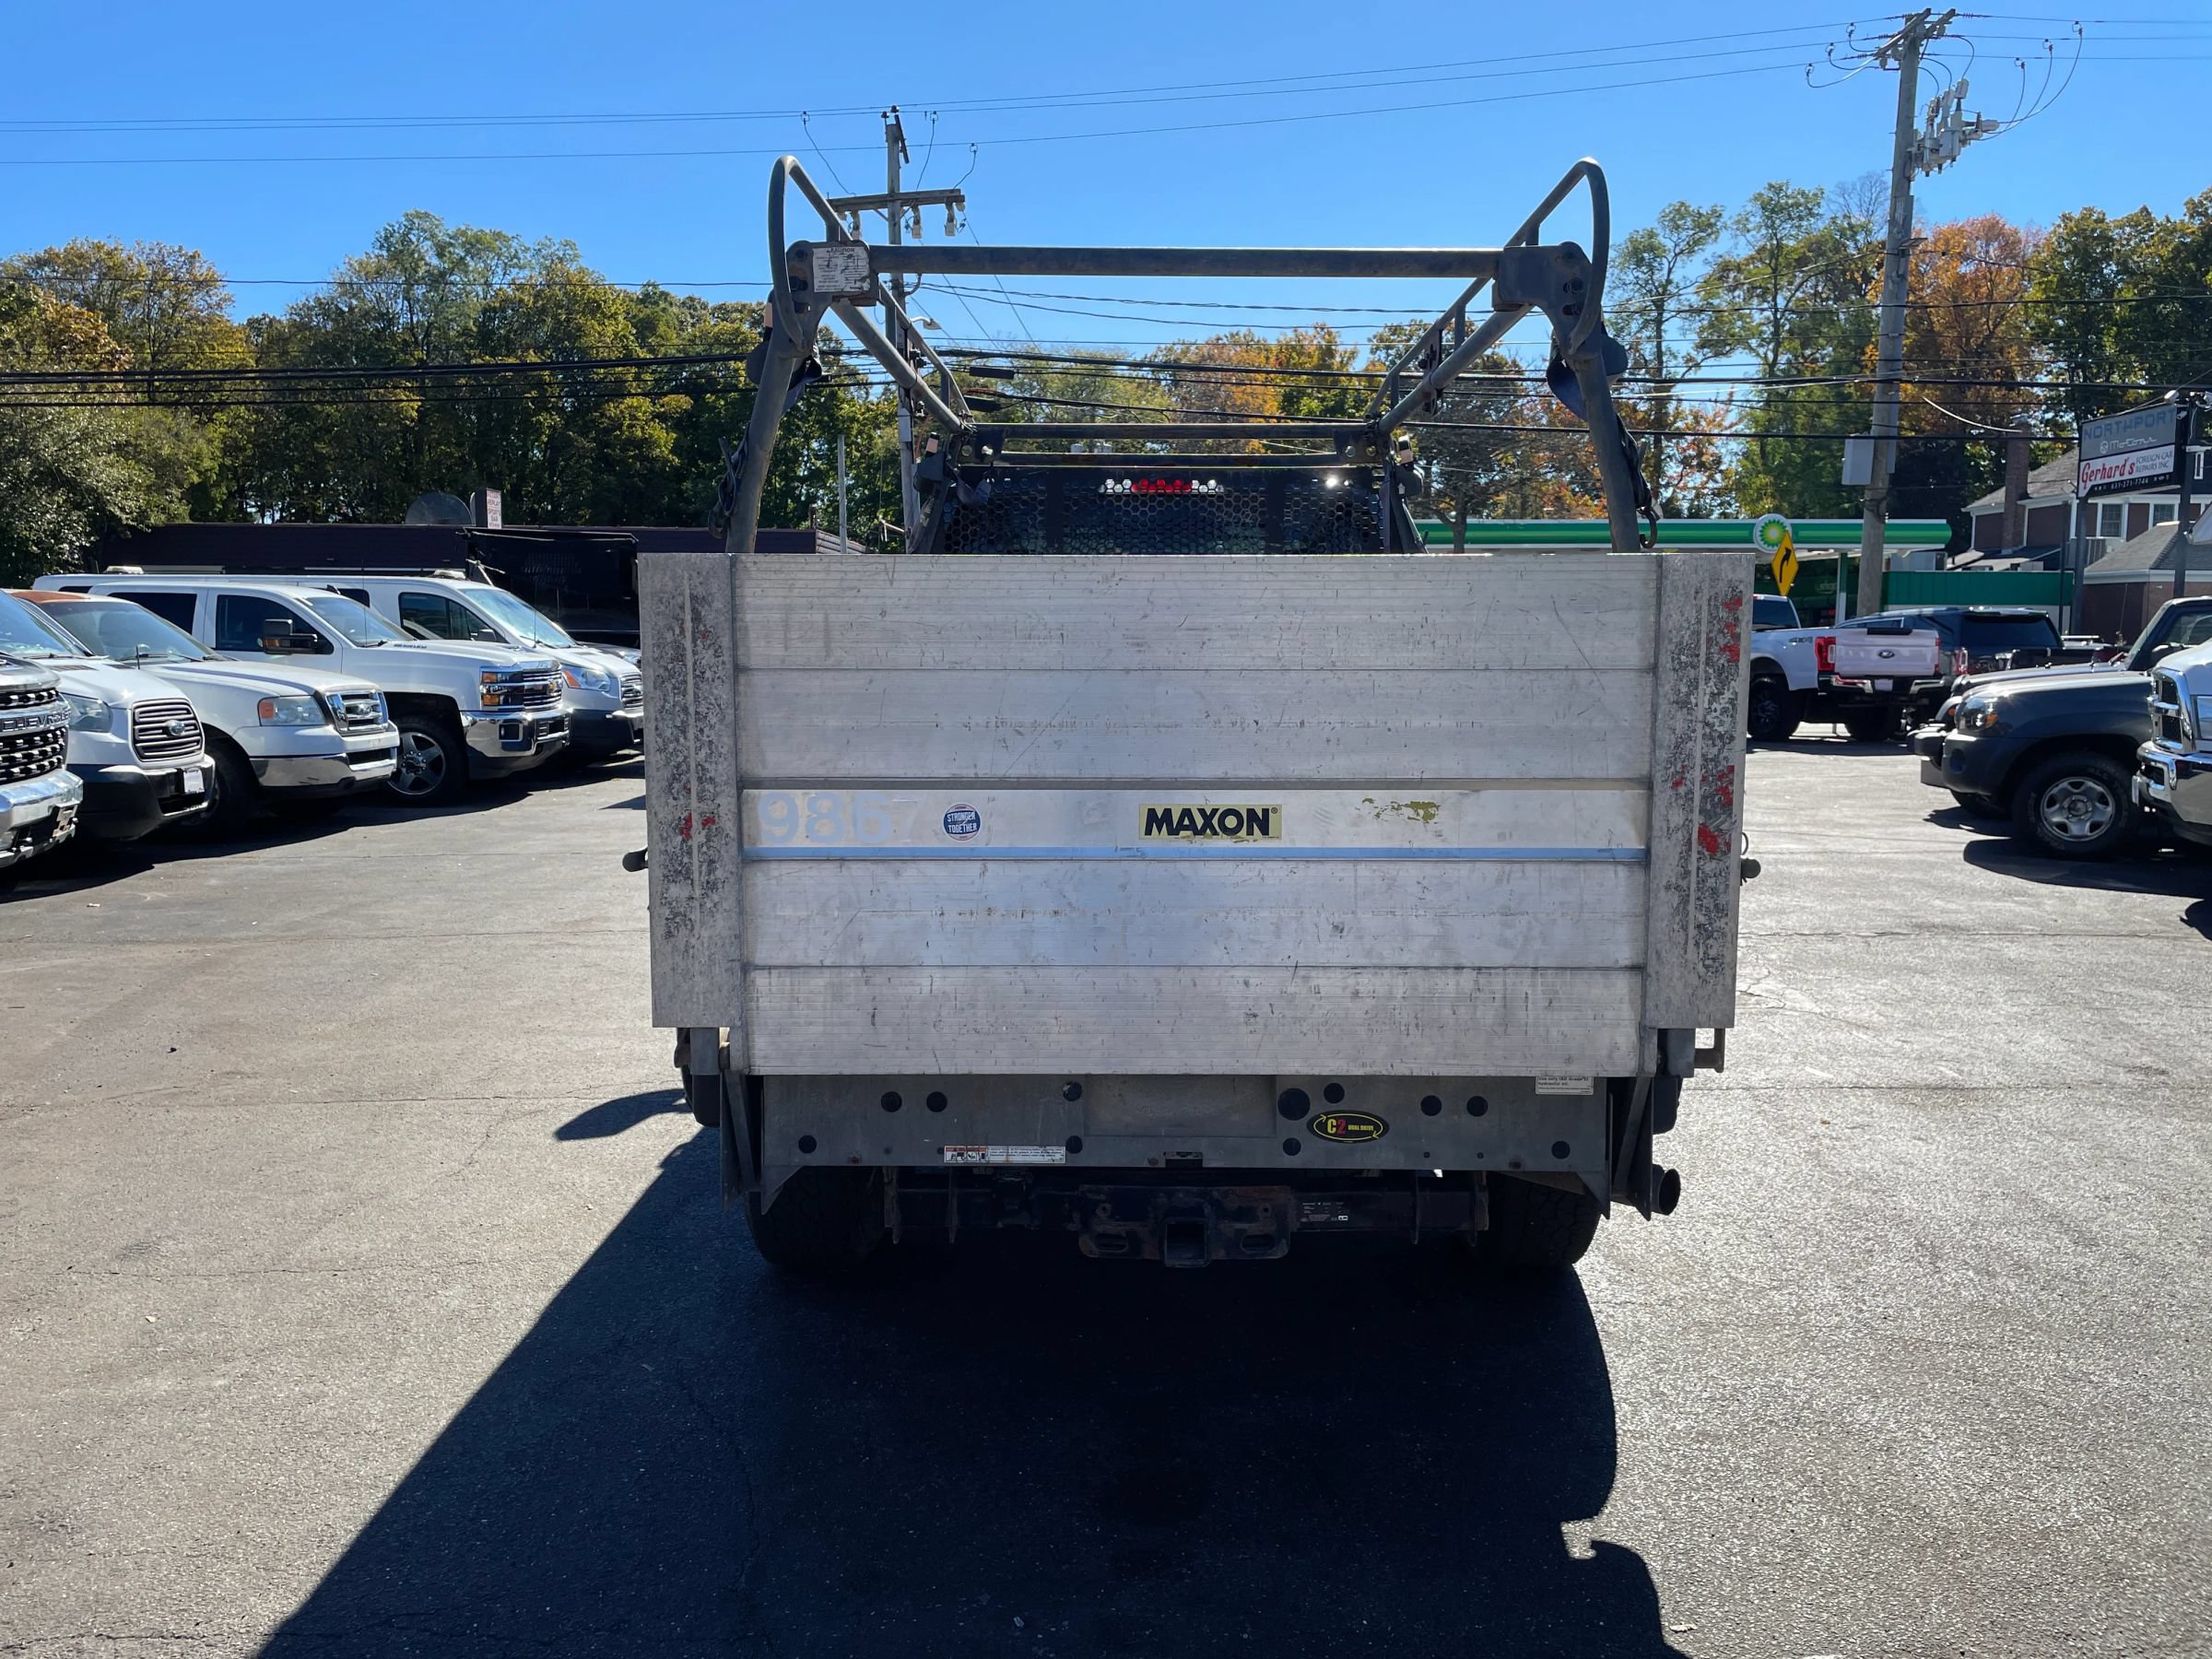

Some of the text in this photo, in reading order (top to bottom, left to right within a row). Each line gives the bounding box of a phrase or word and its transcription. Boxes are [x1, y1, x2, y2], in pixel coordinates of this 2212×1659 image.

[2084, 409, 2175, 441] NORTHPORT
[2161, 451, 2173, 460] CAR
[2081, 457, 2136, 489] Gerhard's
[947, 811, 976, 822] STRONGER
[947, 822, 977, 833] TOGETHER
[1327, 1119, 1346, 1134] C2
